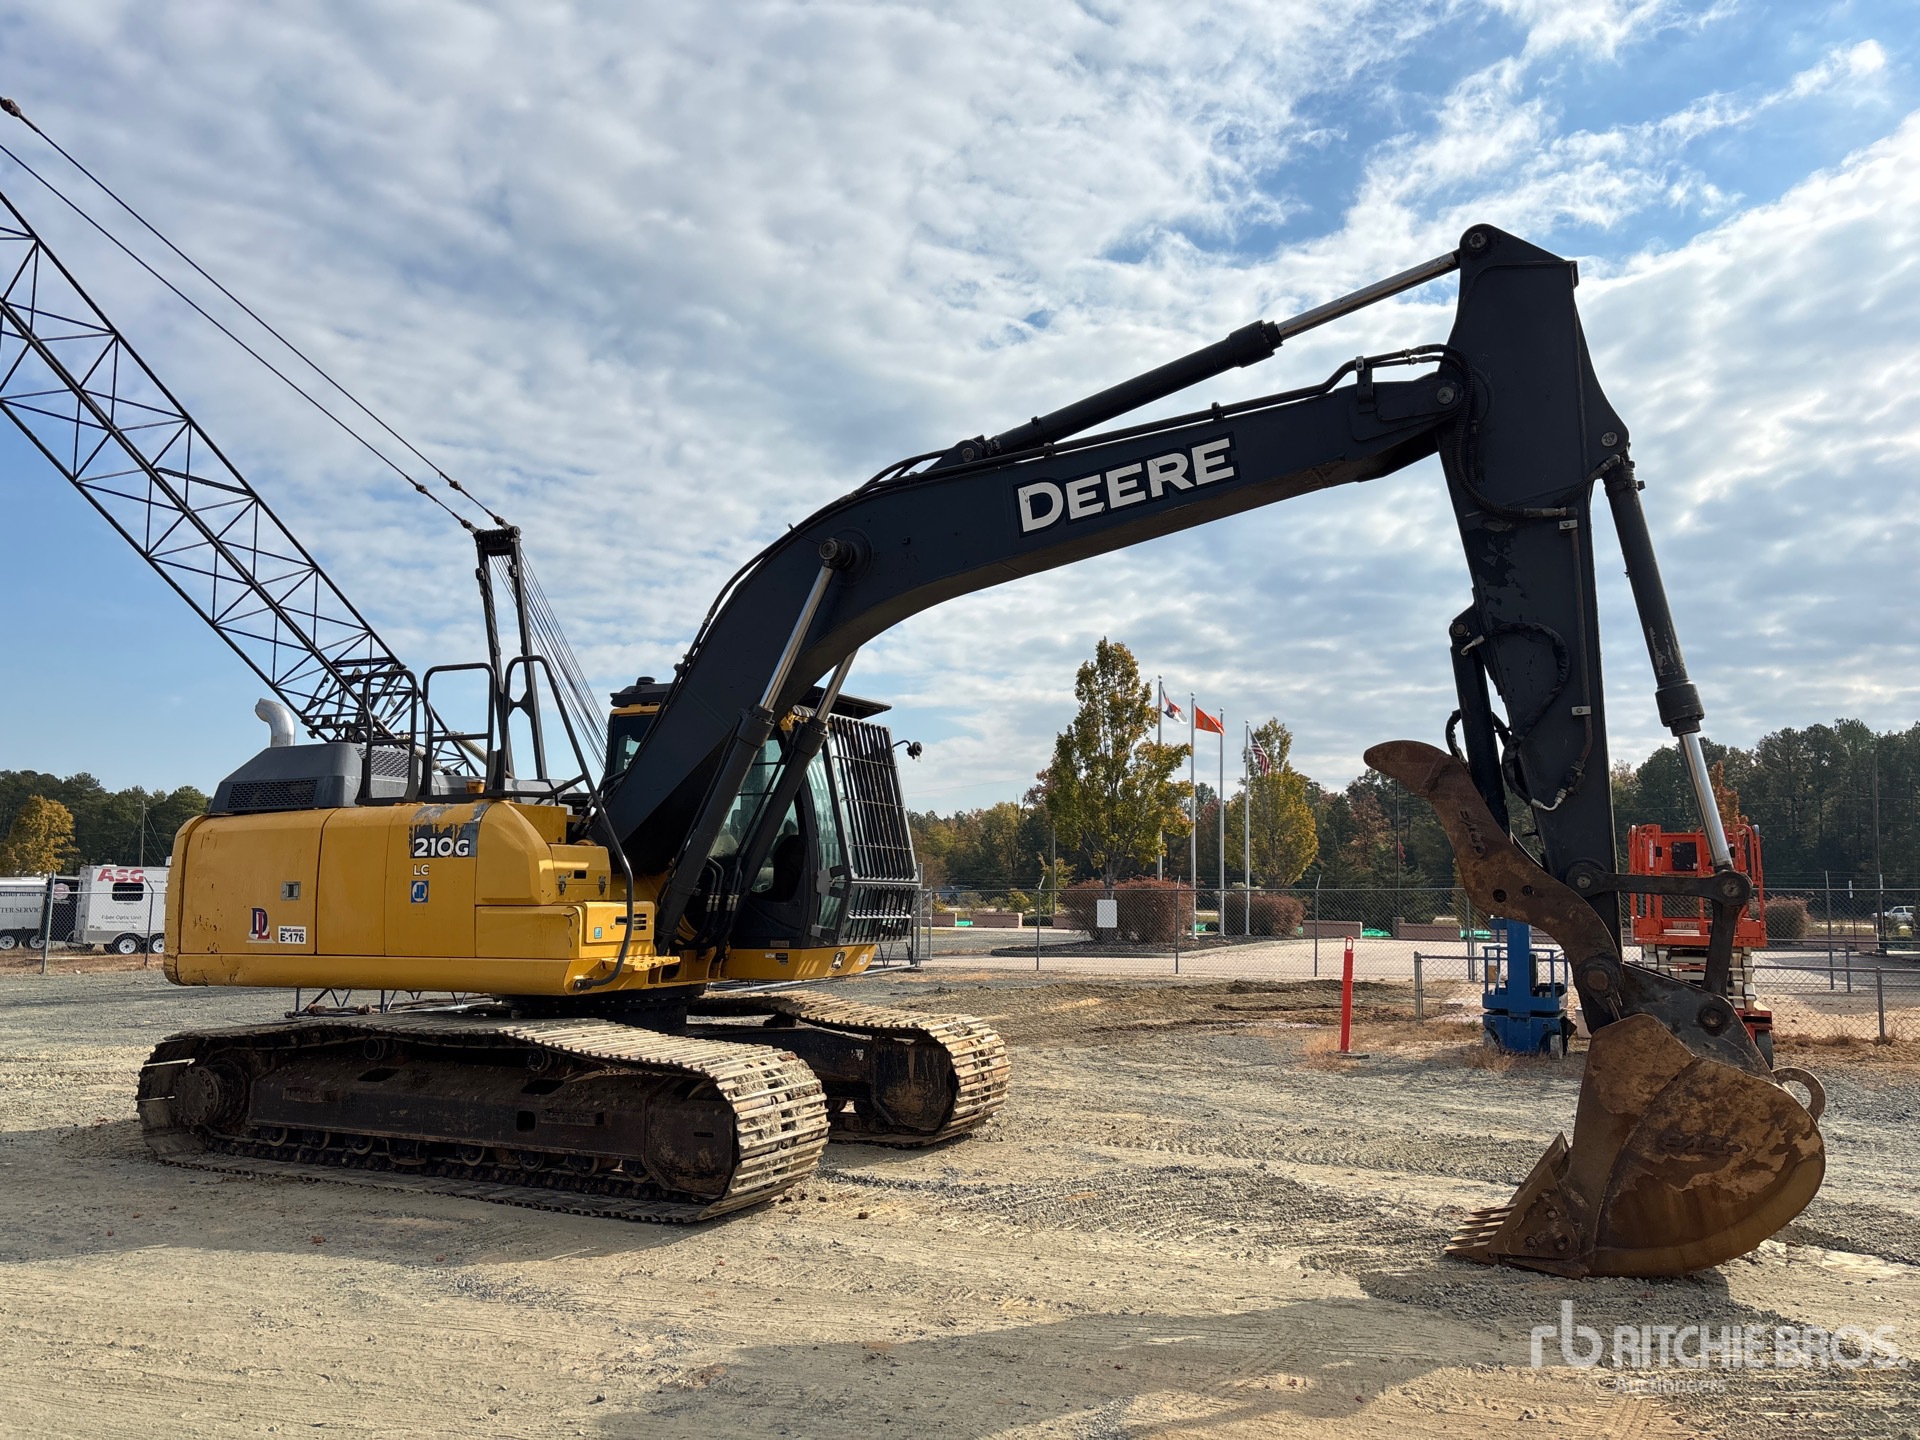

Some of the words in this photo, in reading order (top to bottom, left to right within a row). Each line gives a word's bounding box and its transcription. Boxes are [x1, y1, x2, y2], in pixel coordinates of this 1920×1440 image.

[1018, 438, 1235, 533] DEERE
[414, 837, 469, 857] 210G
[97, 868, 144, 883] ASG
[413, 864, 429, 876] LC
[280, 933, 304, 943] E-176
